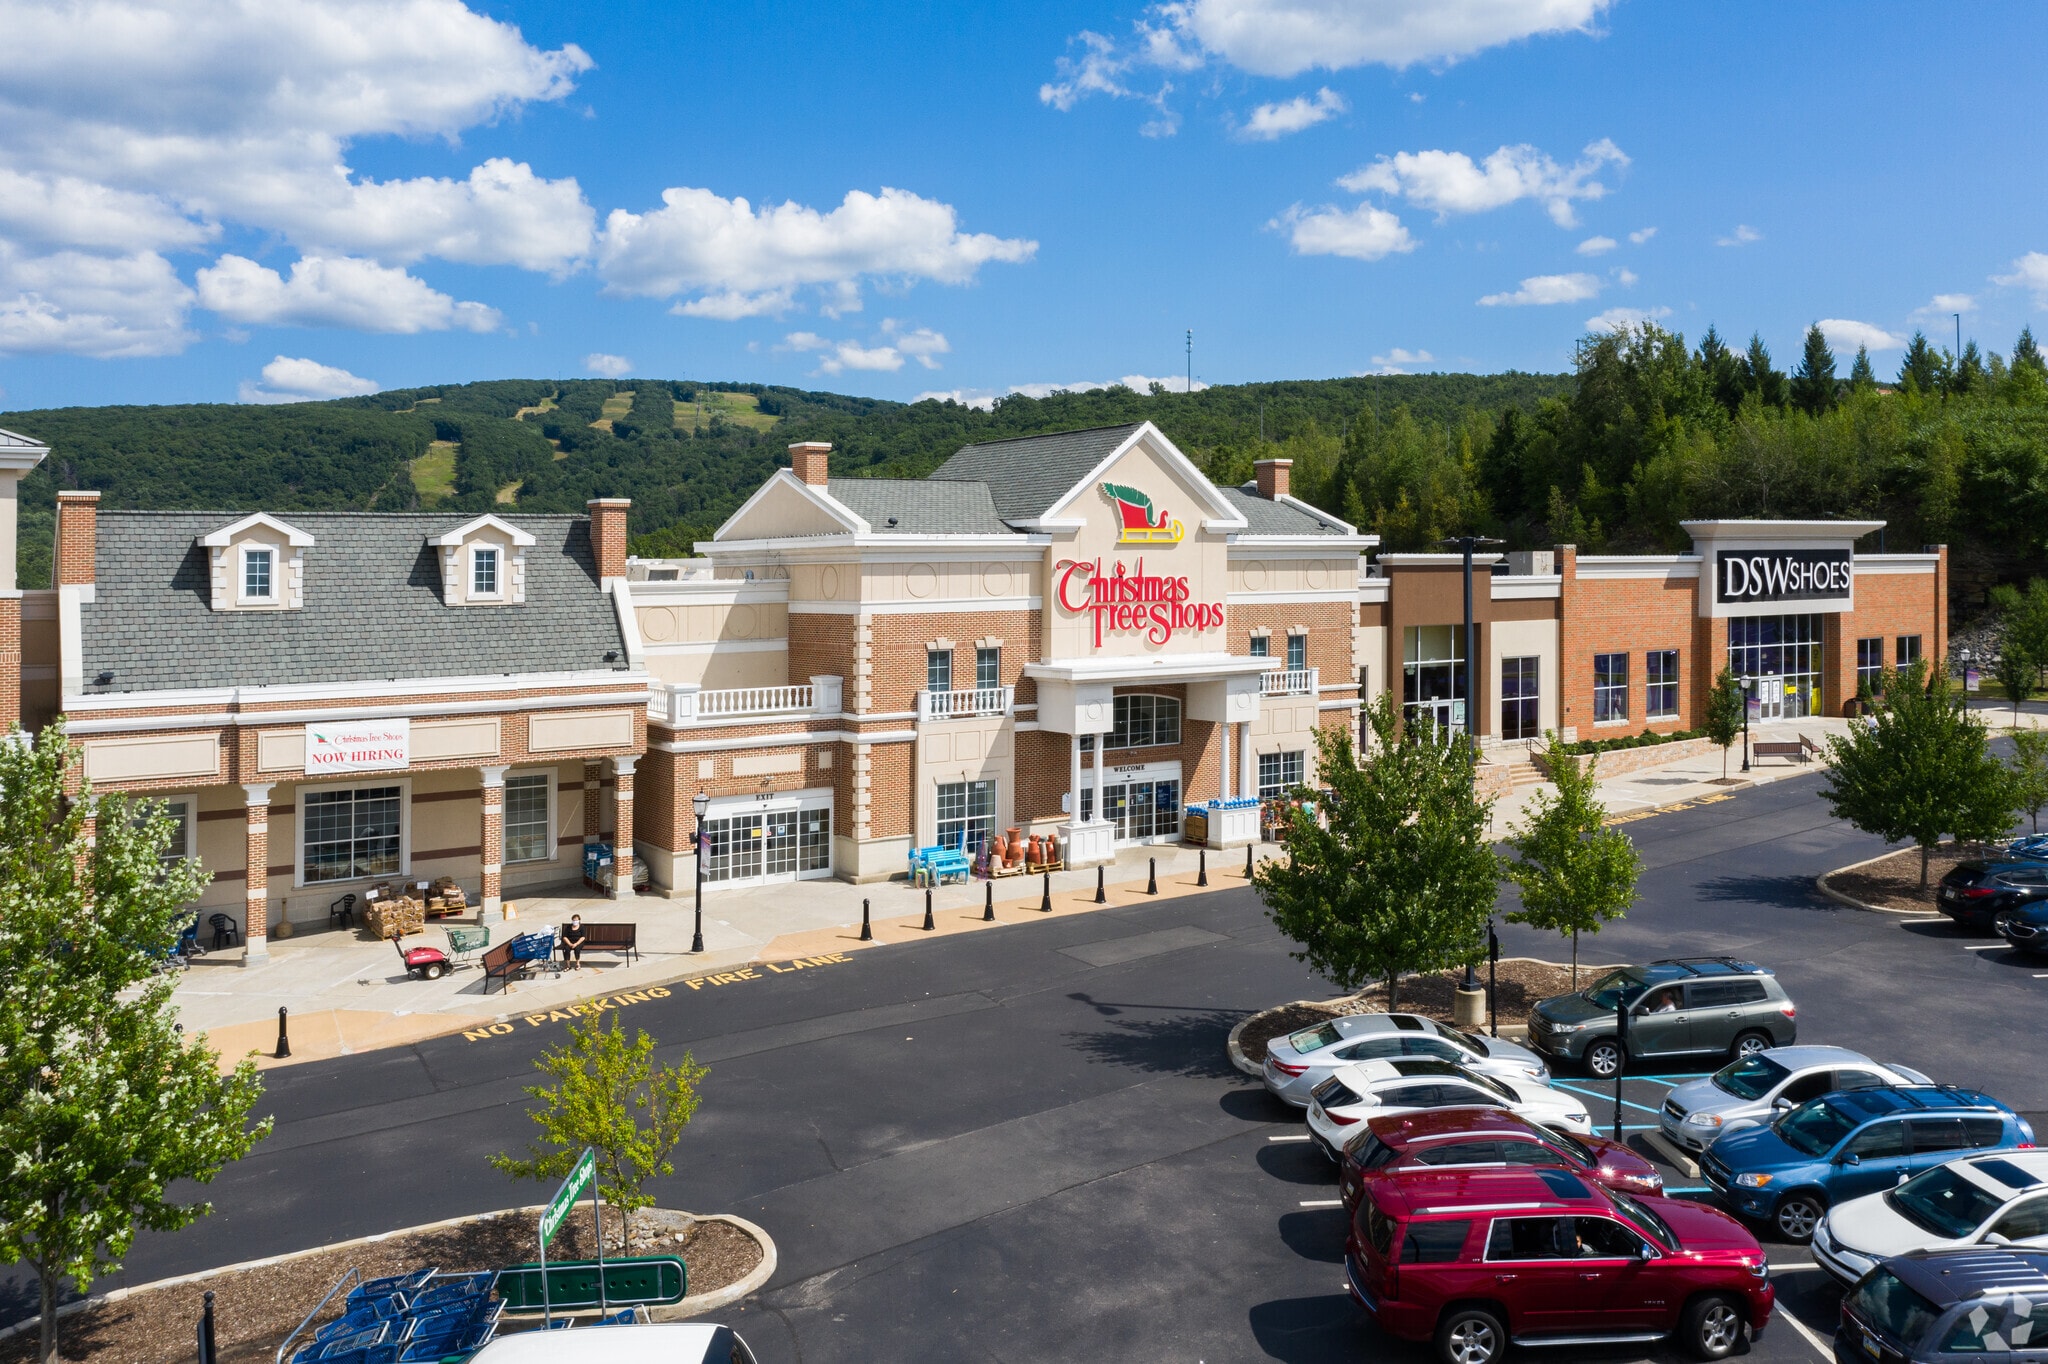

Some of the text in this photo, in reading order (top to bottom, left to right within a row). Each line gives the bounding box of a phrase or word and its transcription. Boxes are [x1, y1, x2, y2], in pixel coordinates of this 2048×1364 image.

[1055, 556, 1190, 612] Christmas
[1724, 556, 1849, 596] DSW SHOES
[1087, 601, 1224, 648] Tree Shops
[312, 749, 403, 764] NOW HIRING
[1113, 764, 1145, 773] WELCOME
[755, 793, 774, 801] EXIT
[462, 1023, 515, 1042] NO
[685, 968, 763, 991] FIRE
[766, 952, 853, 974] LANE
